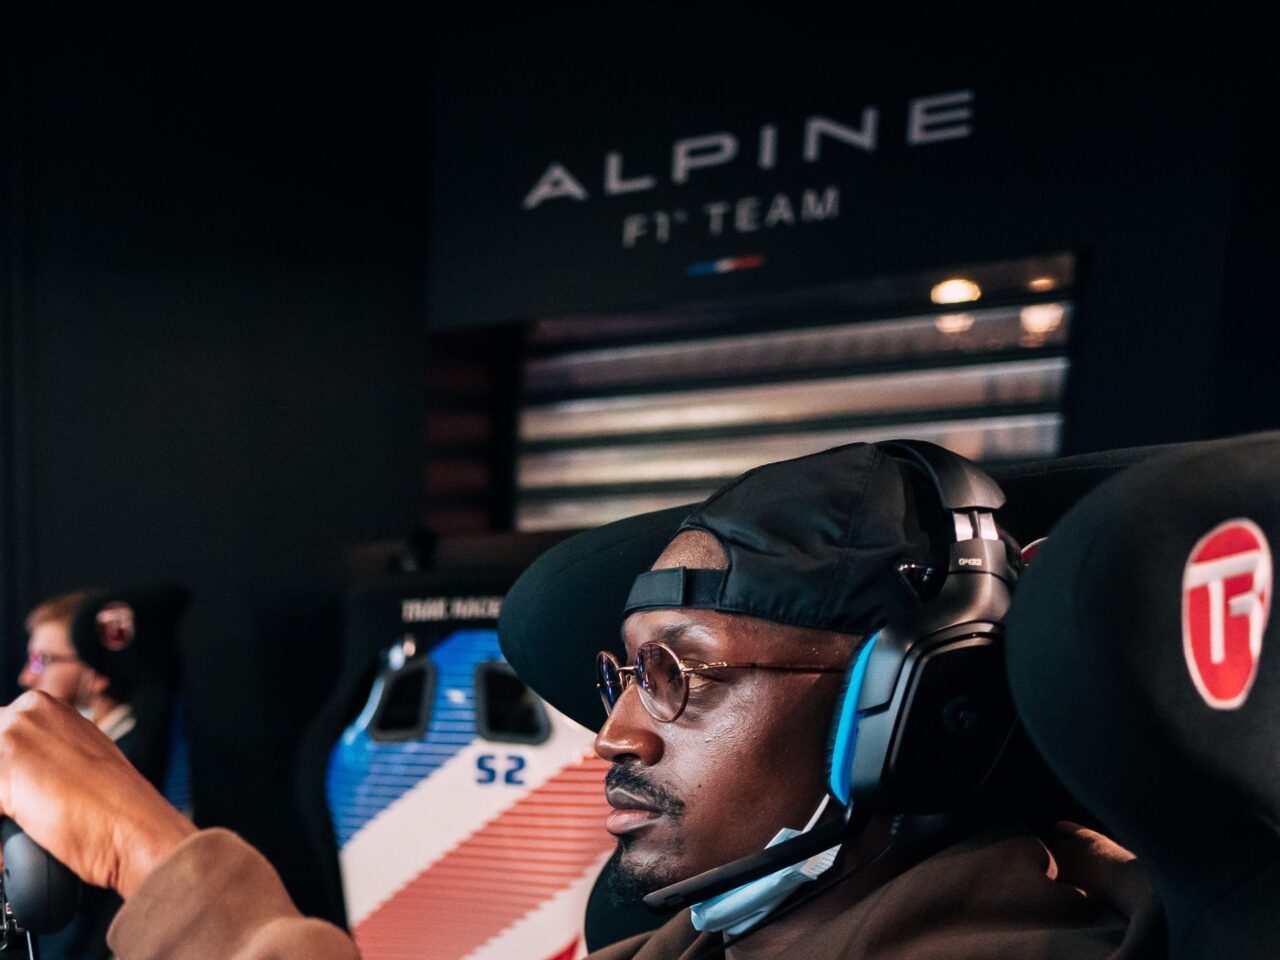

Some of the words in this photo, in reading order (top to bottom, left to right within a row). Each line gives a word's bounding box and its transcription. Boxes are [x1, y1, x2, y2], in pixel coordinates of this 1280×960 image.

[522, 90, 975, 209] ALPINE
[704, 186, 840, 236] TEAM
[475, 754, 526, 785] S2
